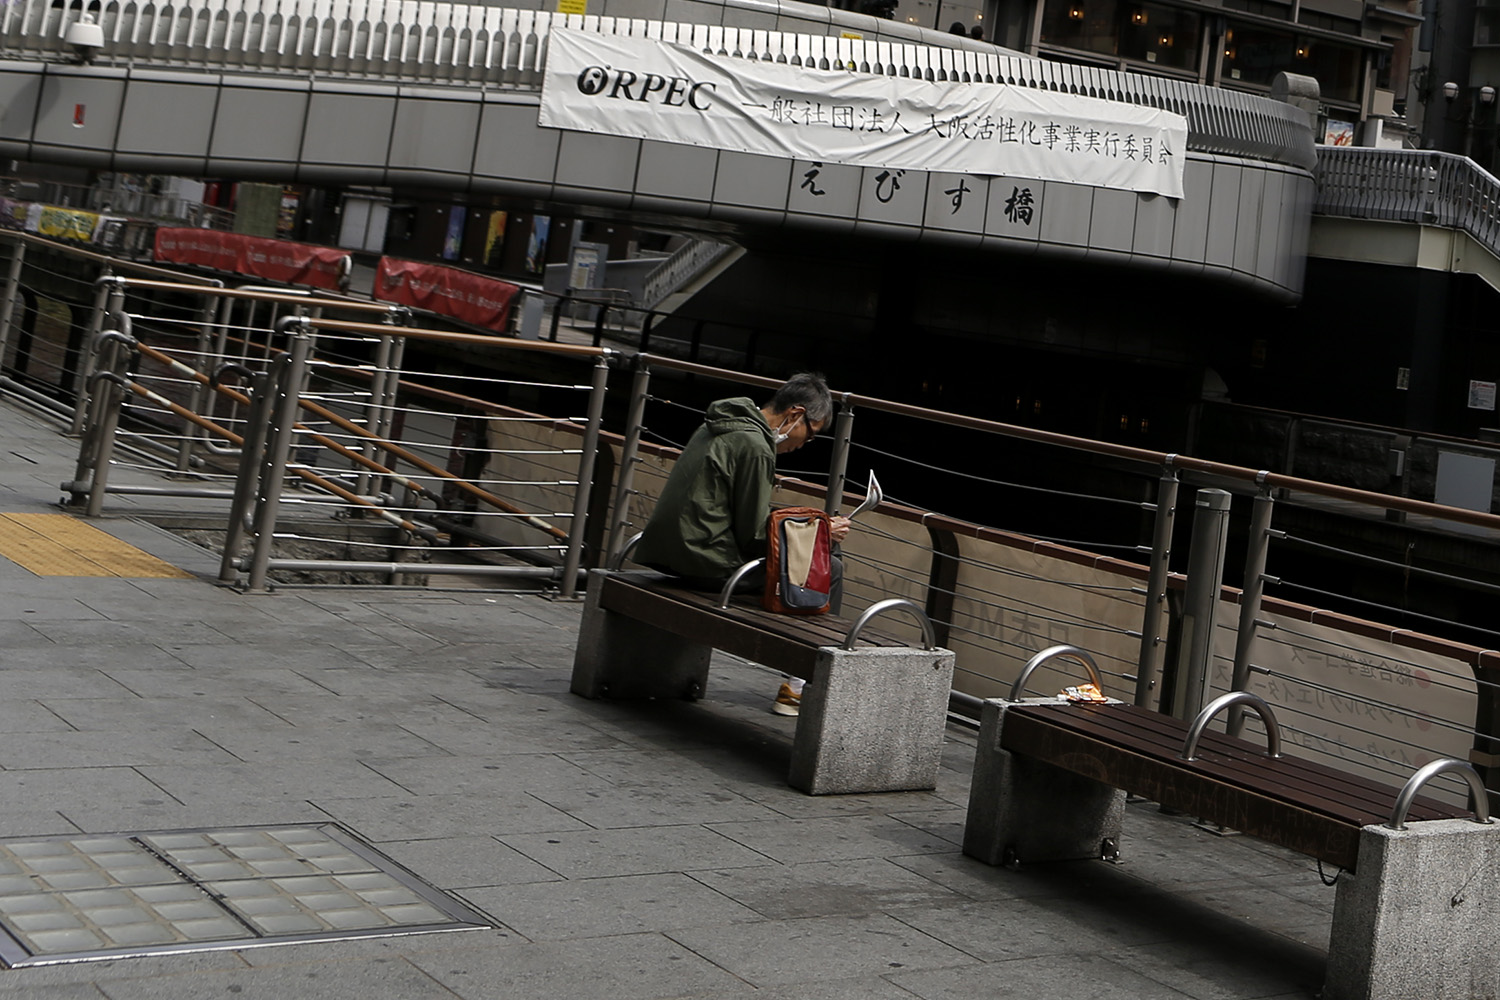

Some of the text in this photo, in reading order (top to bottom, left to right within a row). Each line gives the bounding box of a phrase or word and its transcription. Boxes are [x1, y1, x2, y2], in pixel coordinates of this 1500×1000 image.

[741, 93, 911, 137] 一般社団法人
[801, 161, 1034, 226] えびす橋
